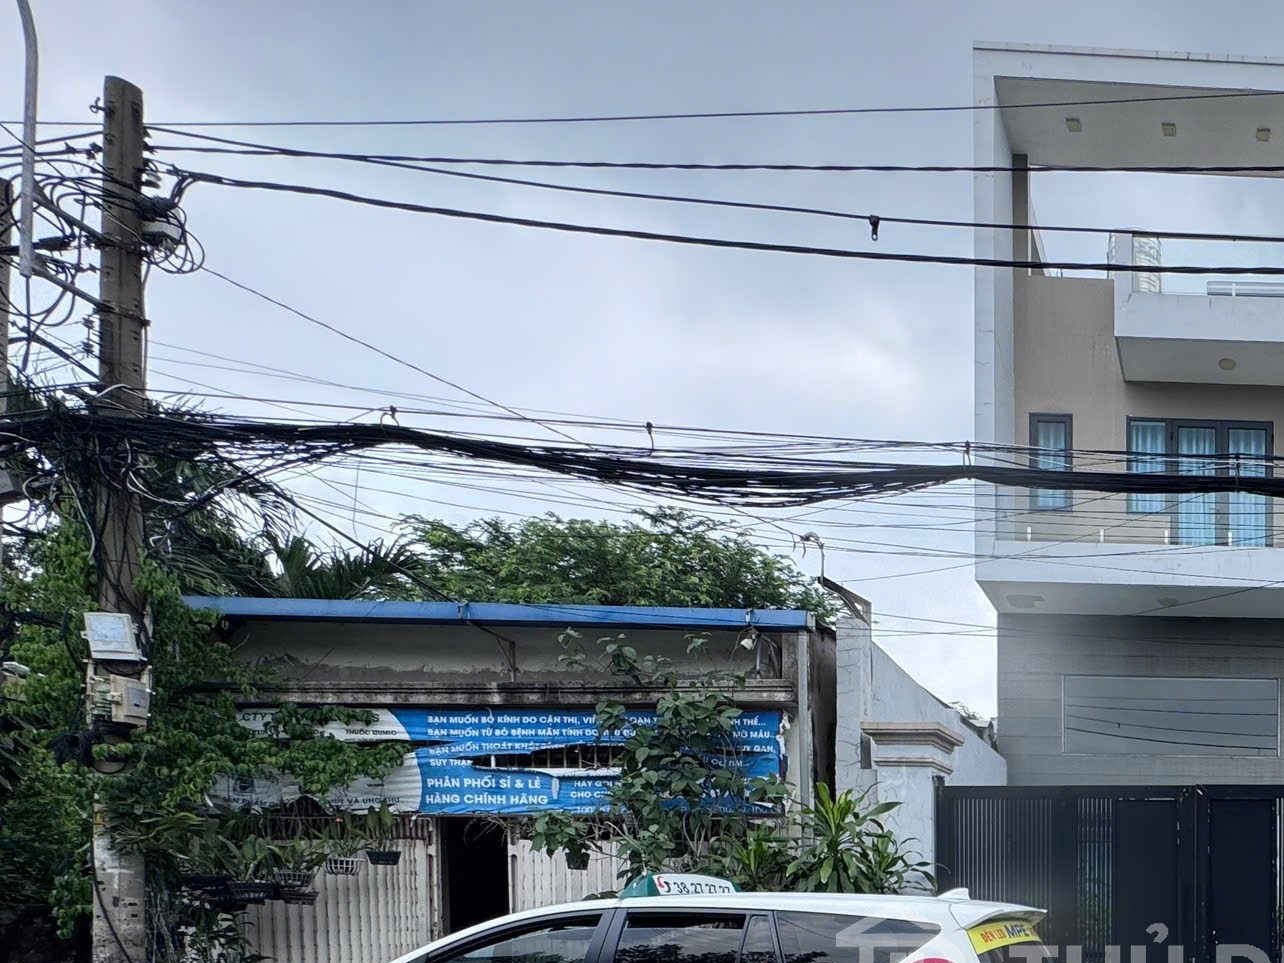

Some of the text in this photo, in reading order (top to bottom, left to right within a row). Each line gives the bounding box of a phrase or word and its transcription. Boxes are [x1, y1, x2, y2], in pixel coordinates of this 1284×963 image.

[427, 715, 447, 726] BẠN
[449, 713, 479, 724] MUỐN
[497, 714, 521, 724] KÍNH
[522, 716, 538, 724] DO
[539, 714, 561, 726] CẬN
[427, 728, 448, 738] BẠN
[449, 727, 479, 738] MUỐN
[562, 727, 584, 737] TÍNH
[429, 758, 447, 768] SUY
[426, 776, 460, 789] PHÂN
[463, 774, 497, 789] PHỐI
[514, 779, 525, 789] &
[425, 791, 461, 804] HÀNG
[463, 792, 507, 805] CHÍNH
[570, 791, 592, 799] CHO
[705, 882, 717, 895] 27
